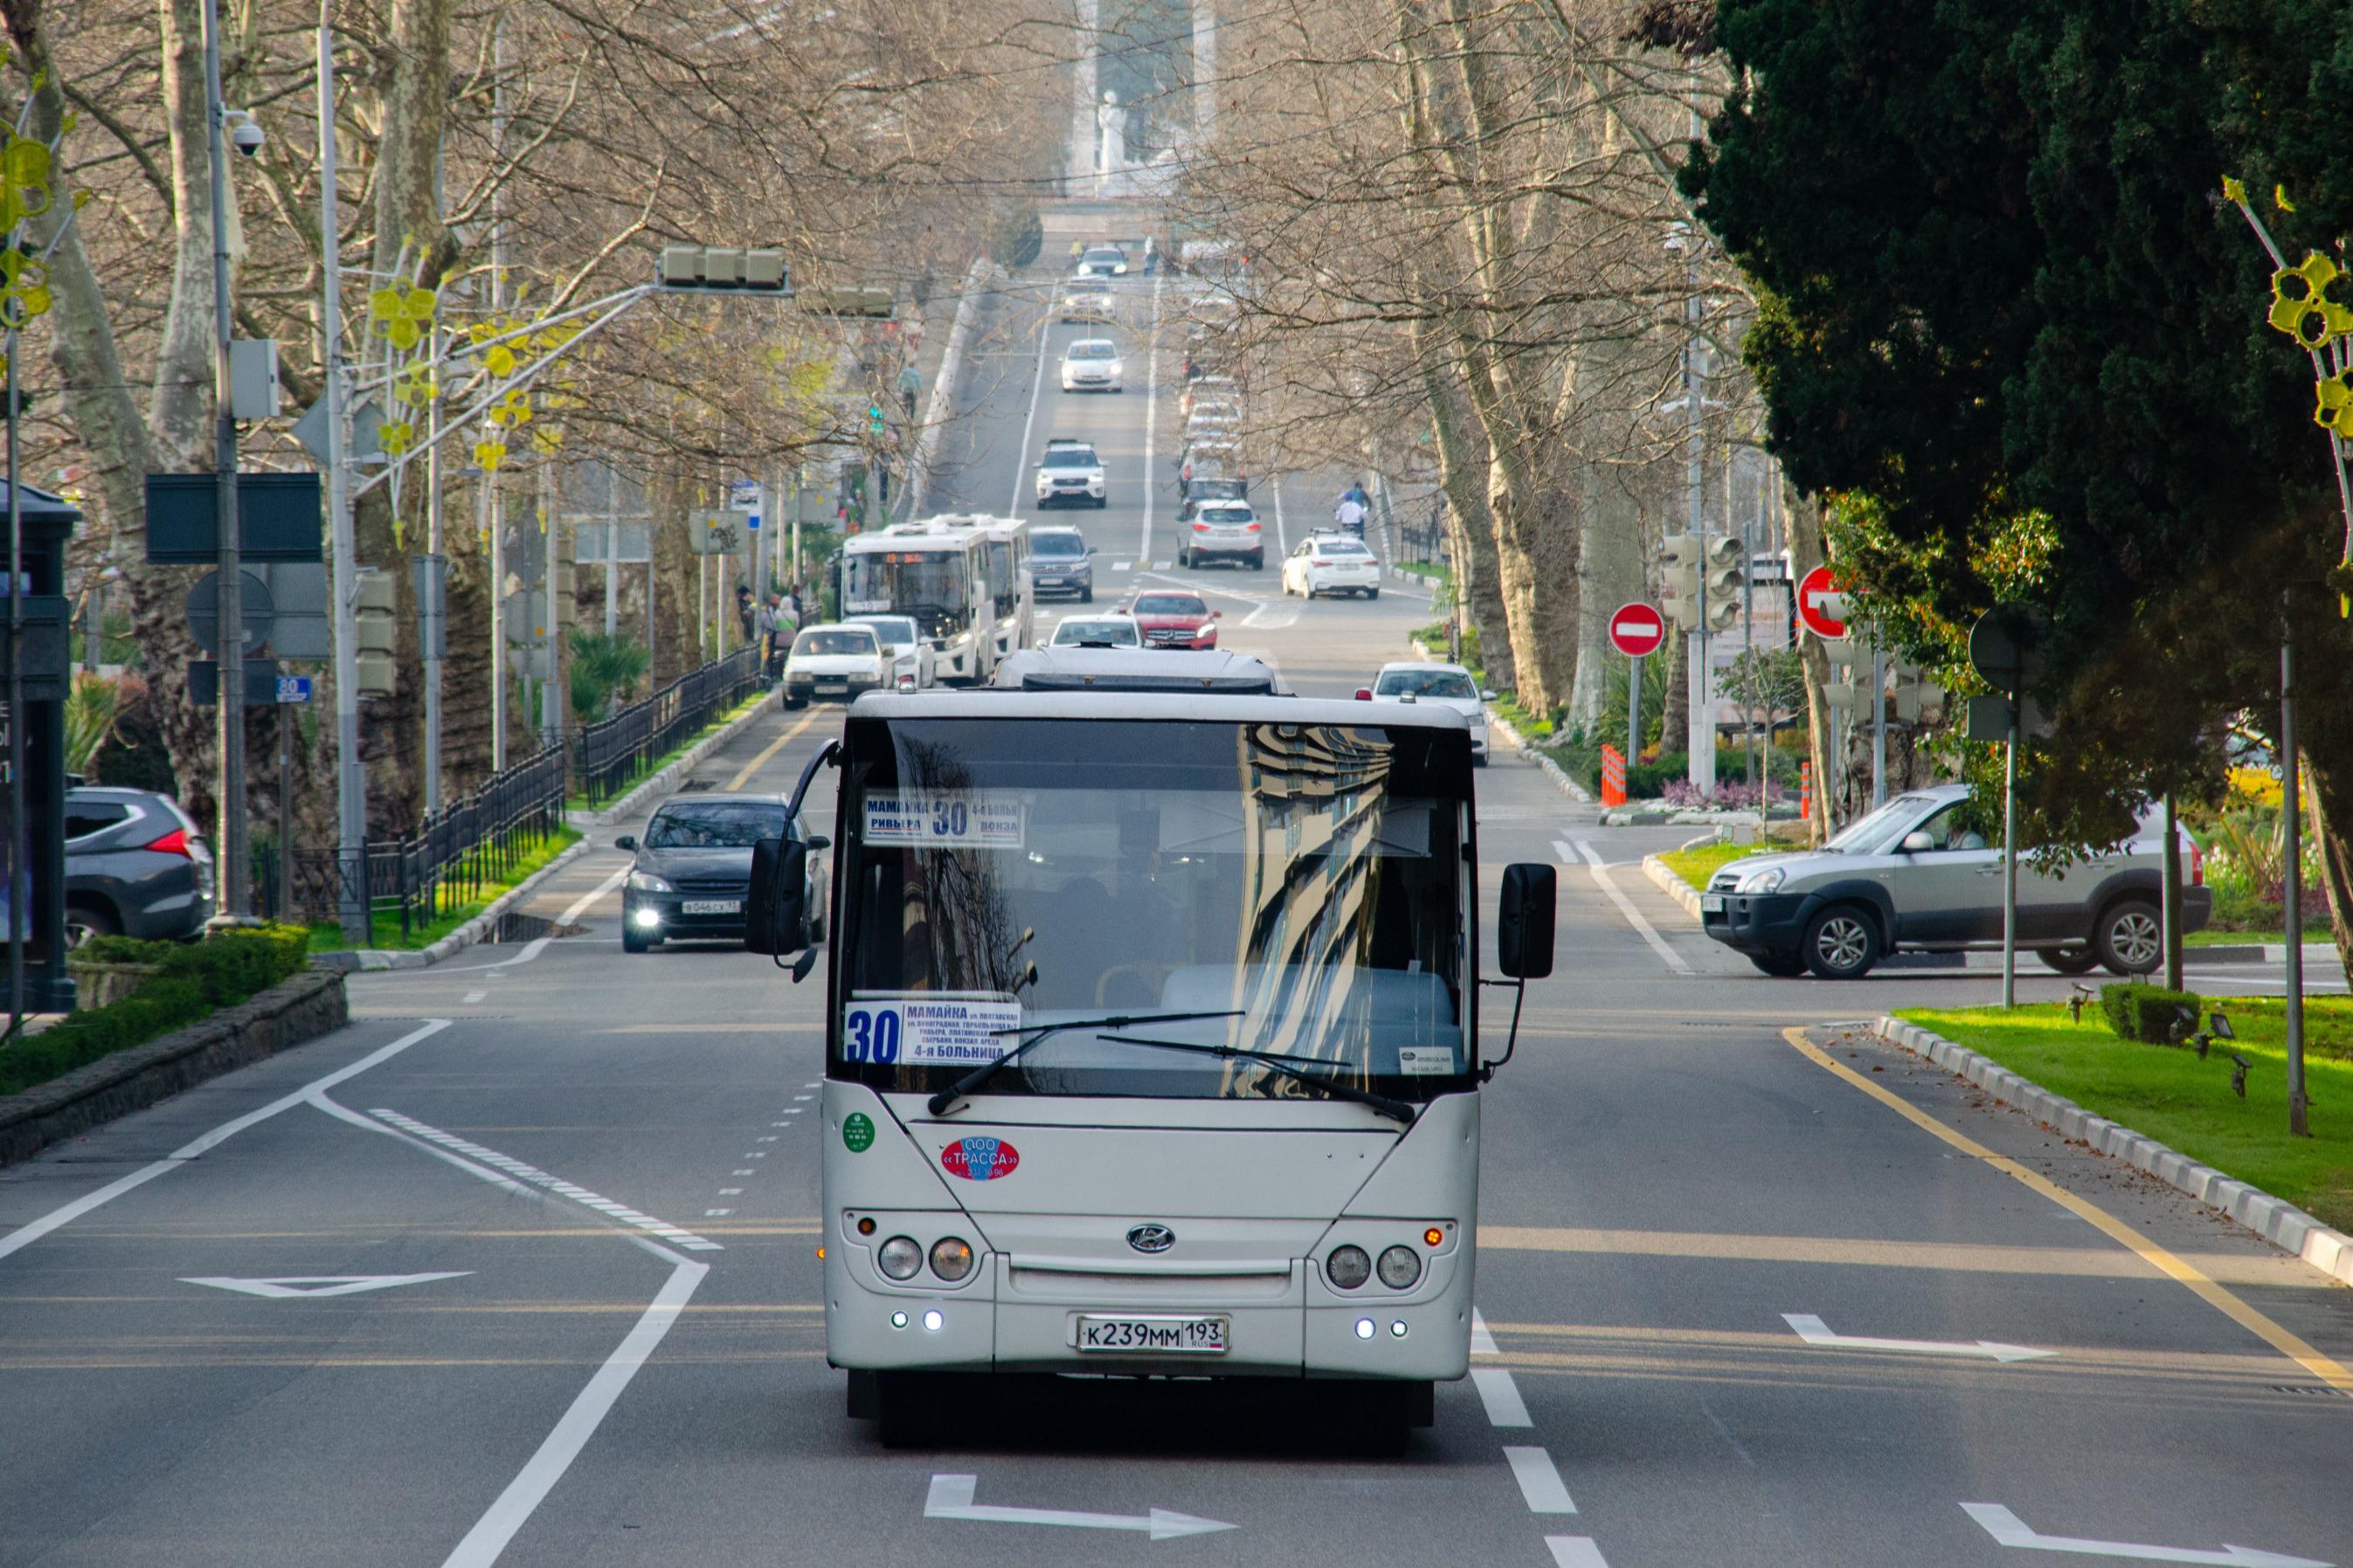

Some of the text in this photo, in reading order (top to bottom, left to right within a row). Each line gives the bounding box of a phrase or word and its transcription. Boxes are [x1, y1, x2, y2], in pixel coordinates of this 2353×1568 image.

[871, 819, 921, 829] РИВЬЕРА
[932, 801, 967, 836] 30
[907, 1005, 967, 1019] МАМАЙКА
[847, 1010, 899, 1063] 30
[915, 1046, 1004, 1060] 4-я БОЛЬНИЦА
[1185, 1323, 1219, 1341] 193
